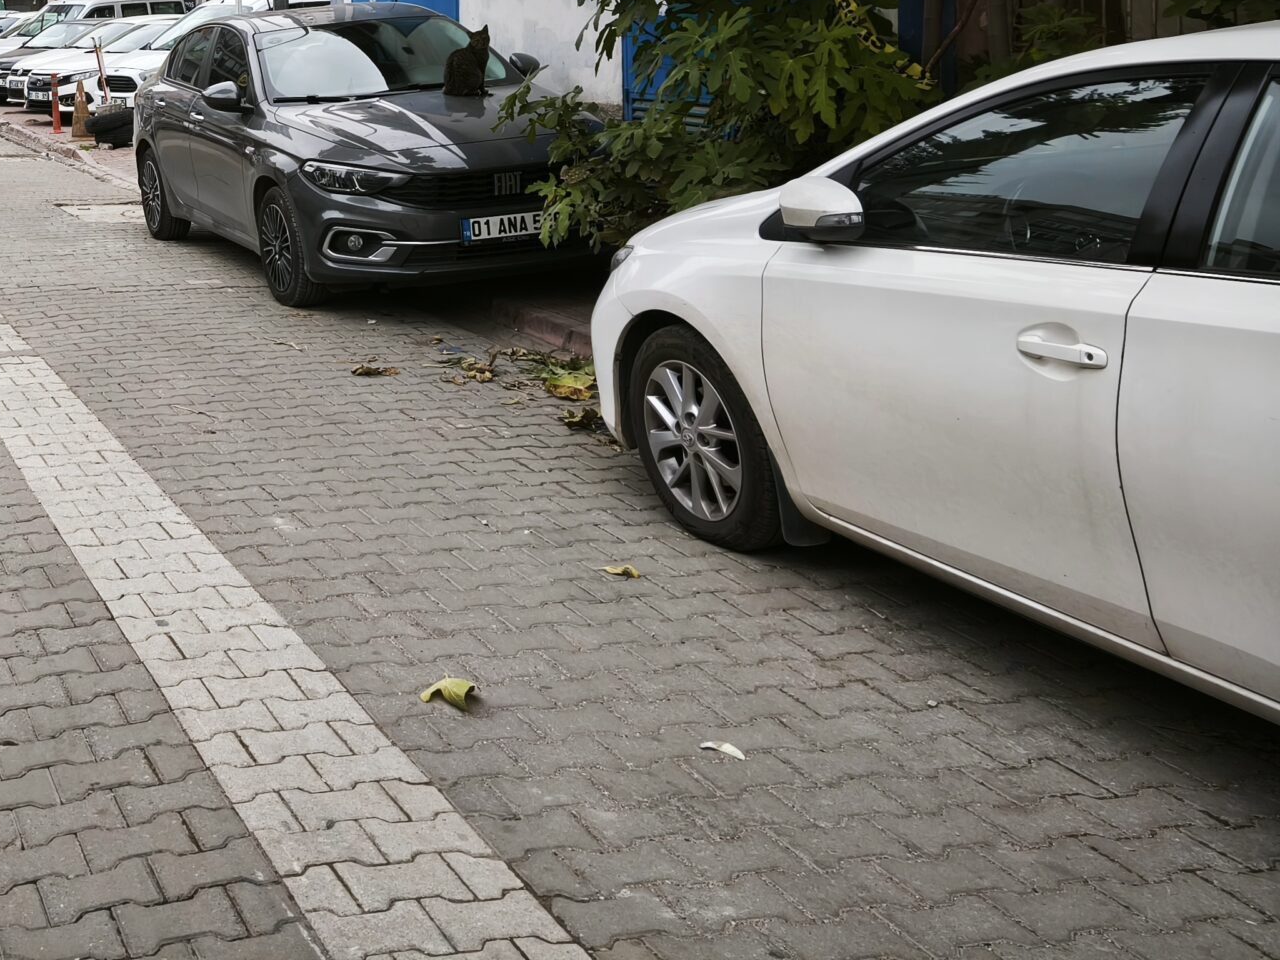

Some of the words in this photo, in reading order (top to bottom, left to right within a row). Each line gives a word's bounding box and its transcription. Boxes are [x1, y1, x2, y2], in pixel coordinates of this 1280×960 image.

[493, 171, 523, 196] FIAT
[471, 219, 492, 238] 01
[498, 215, 529, 236] ANA
